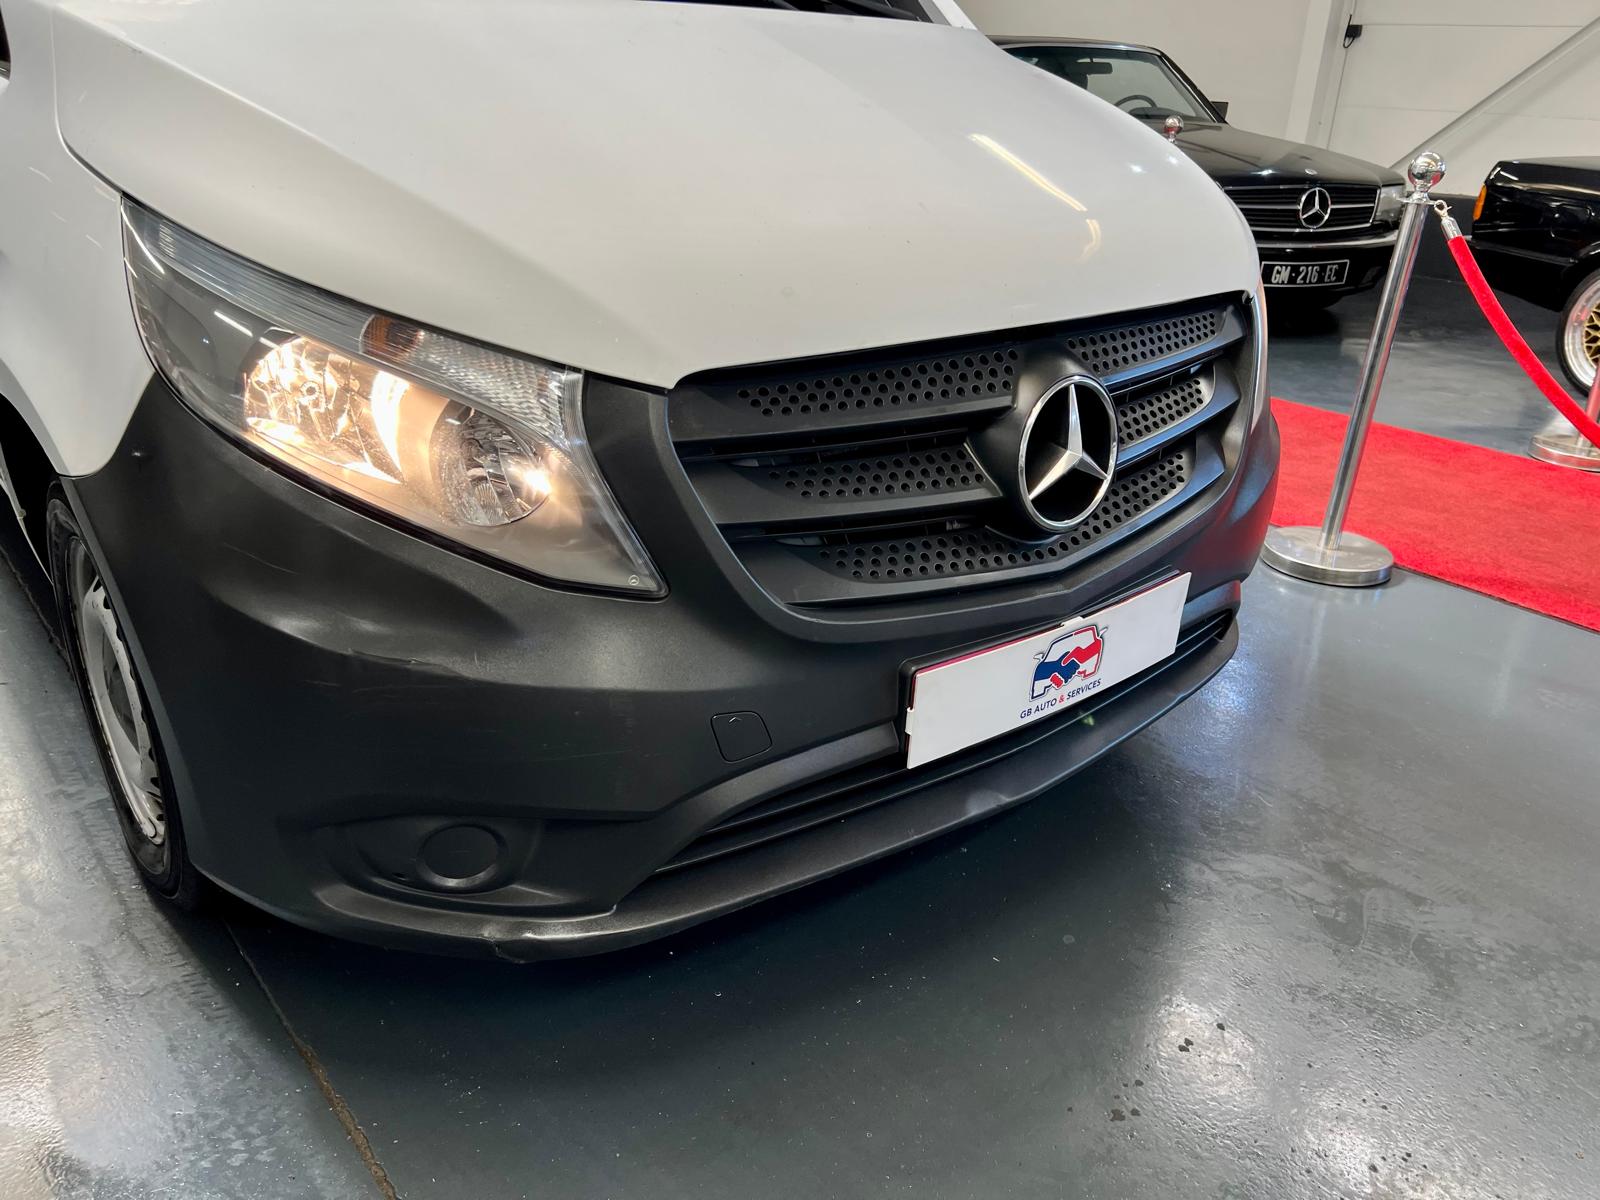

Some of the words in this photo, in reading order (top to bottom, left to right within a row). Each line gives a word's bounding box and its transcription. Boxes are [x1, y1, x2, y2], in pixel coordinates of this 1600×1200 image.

[1020, 708, 1032, 719] GB
[1034, 698, 1057, 713] AUTO
[1058, 694, 1065, 704] &
[1066, 678, 1101, 700] SERVICES
